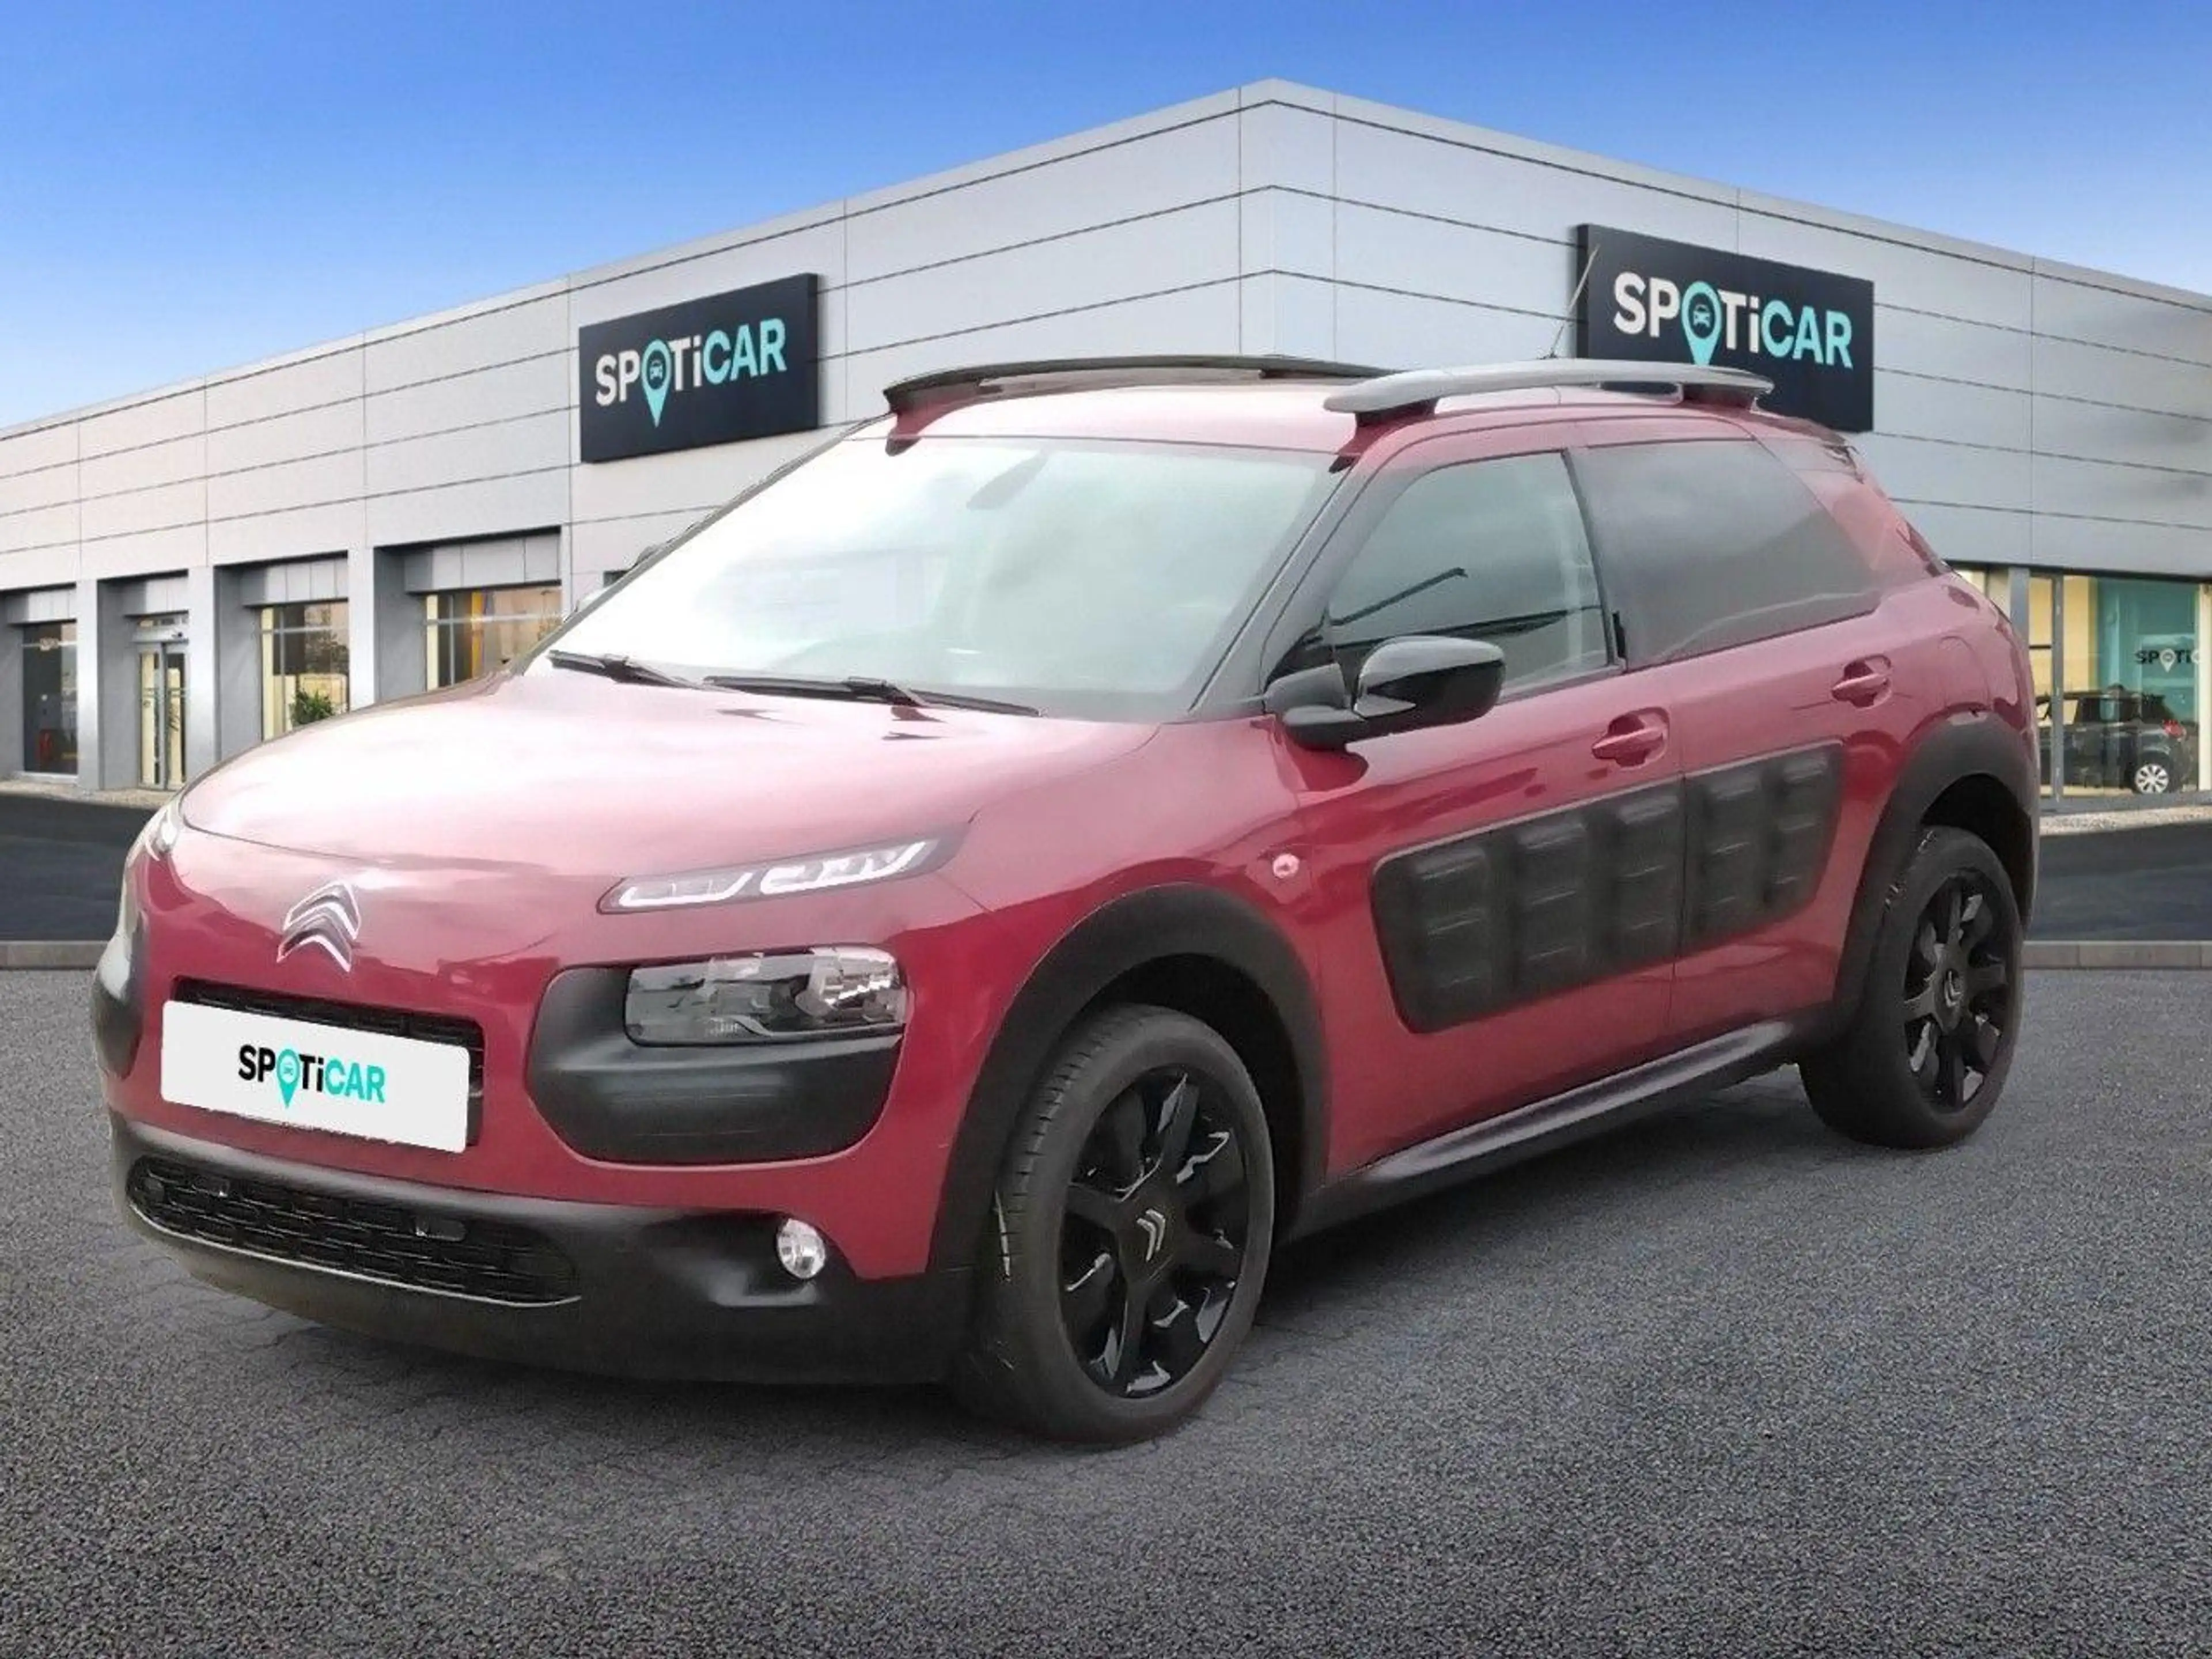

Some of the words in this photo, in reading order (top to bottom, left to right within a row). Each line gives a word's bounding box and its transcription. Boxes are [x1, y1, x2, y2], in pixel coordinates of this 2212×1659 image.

[1613, 271, 1853, 368] SPOTiCAR
[596, 318, 787, 427] SPOTiCAR
[238, 1044, 385, 1108] SPOTiCAR
